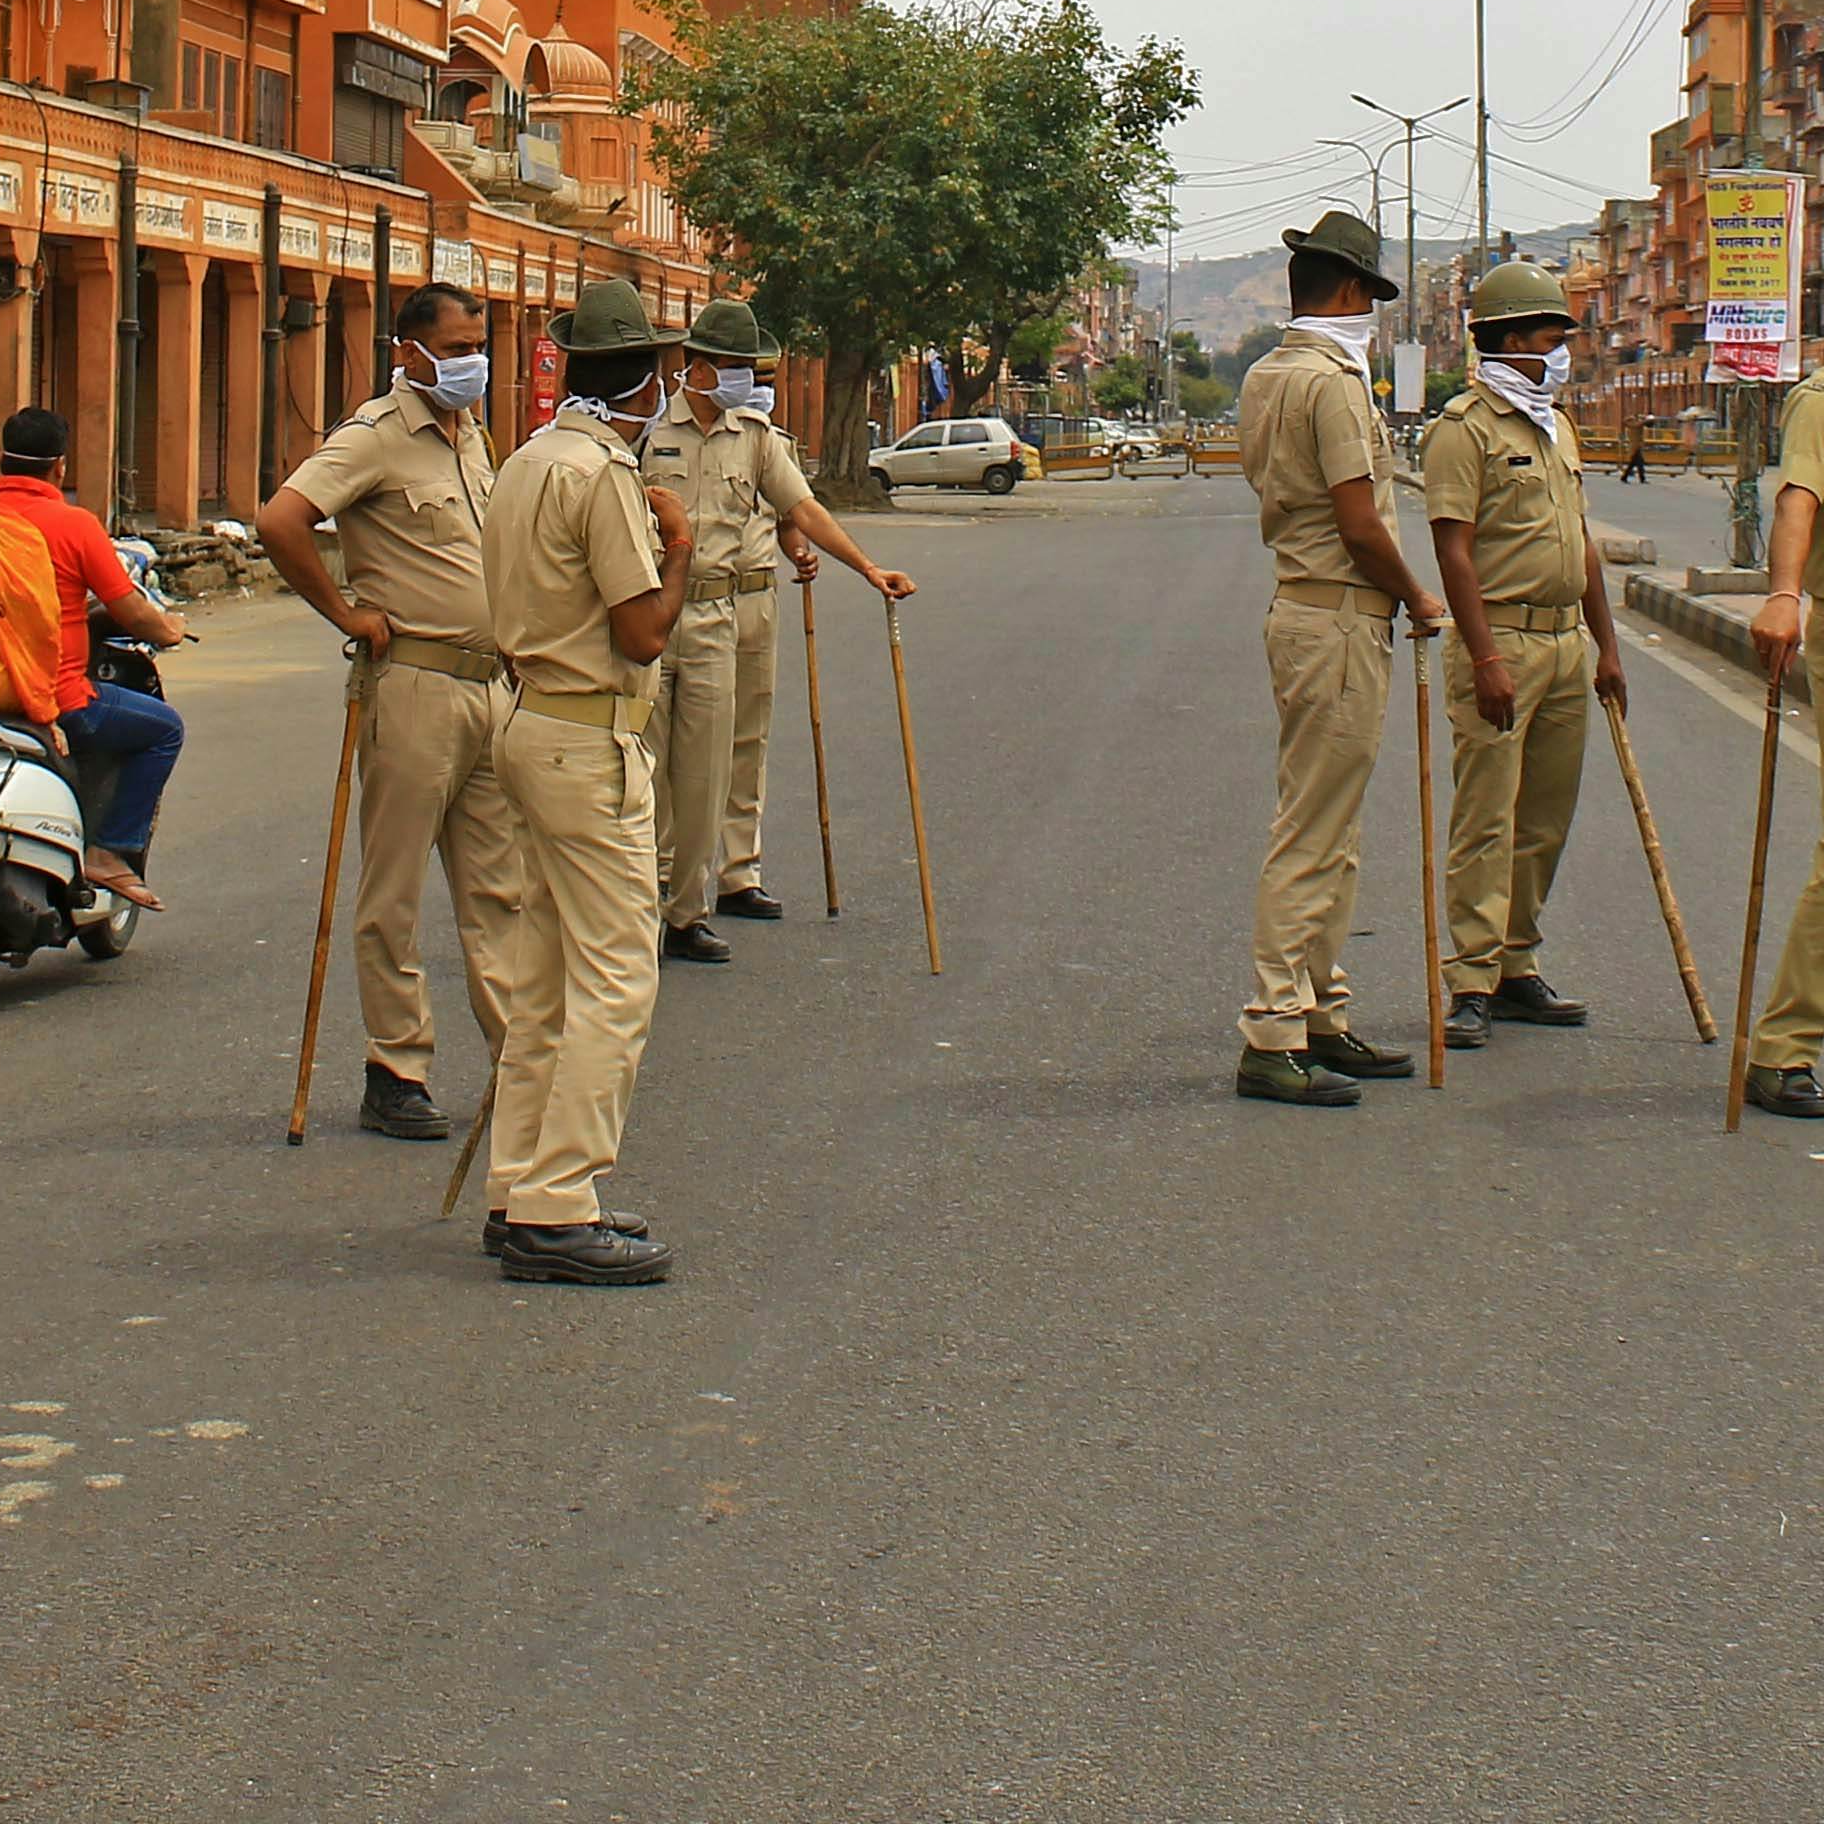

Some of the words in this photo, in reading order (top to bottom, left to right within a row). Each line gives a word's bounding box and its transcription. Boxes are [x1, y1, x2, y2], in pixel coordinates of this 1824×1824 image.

[1730, 182, 1785, 191] Foundation
[1738, 192, 1755, 213] ॐ
[1711, 212, 1748, 229] भारतीय
[1751, 211, 1784, 229] नववर्ष
[1716, 232, 1764, 247] मंगलमय
[1769, 232, 1781, 248] हो
[1725, 328, 1769, 340] BOOKS
